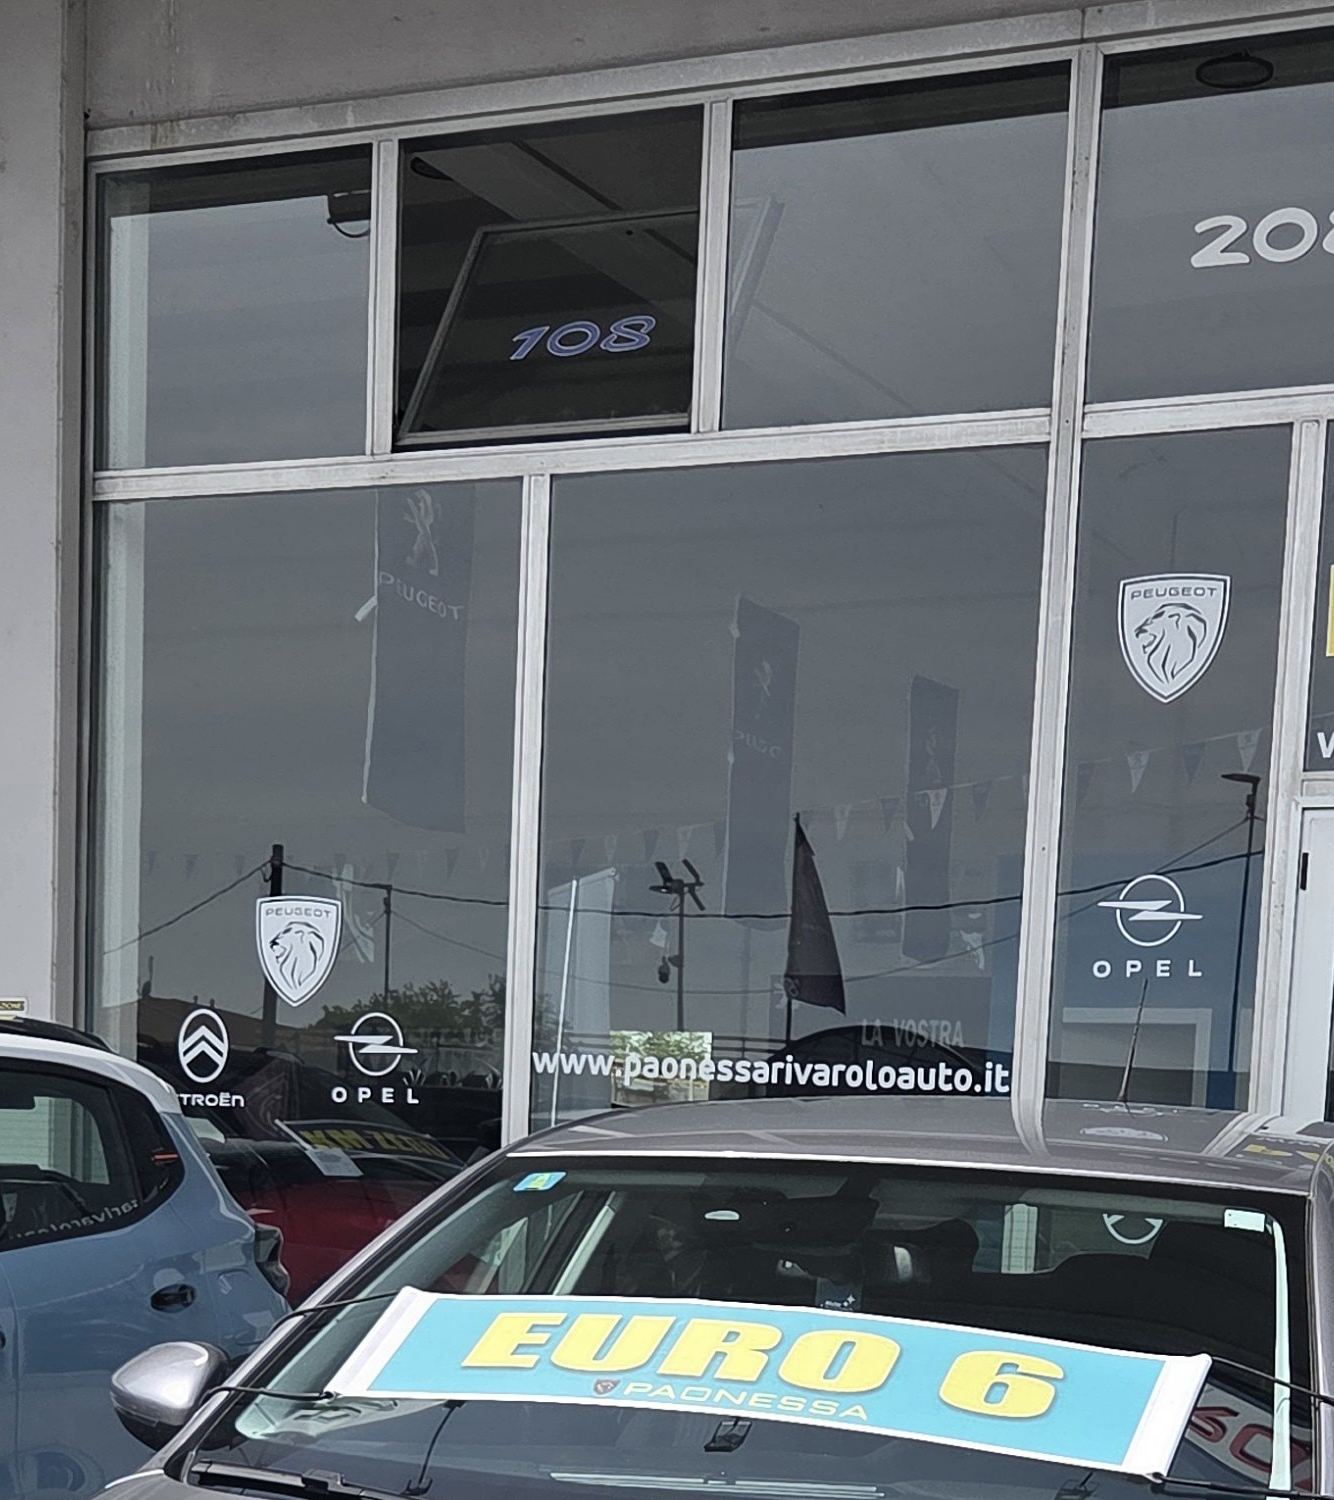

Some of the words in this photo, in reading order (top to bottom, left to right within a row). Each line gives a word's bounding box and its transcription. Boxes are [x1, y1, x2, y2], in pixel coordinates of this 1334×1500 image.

[509, 315, 656, 362] 108
[1129, 585, 1218, 602] PEUGEOT
[265, 907, 332, 919] PEUGEOT
[1092, 959, 1203, 979] OPEL
[532, 1050, 1010, 1094] www.paonessarivaroloauto.it
[330, 1087, 419, 1104] OPEL
[461, 1311, 902, 1397] EURO
[939, 1350, 1066, 1420] 6
[624, 1382, 867, 1421] PAONESSA
